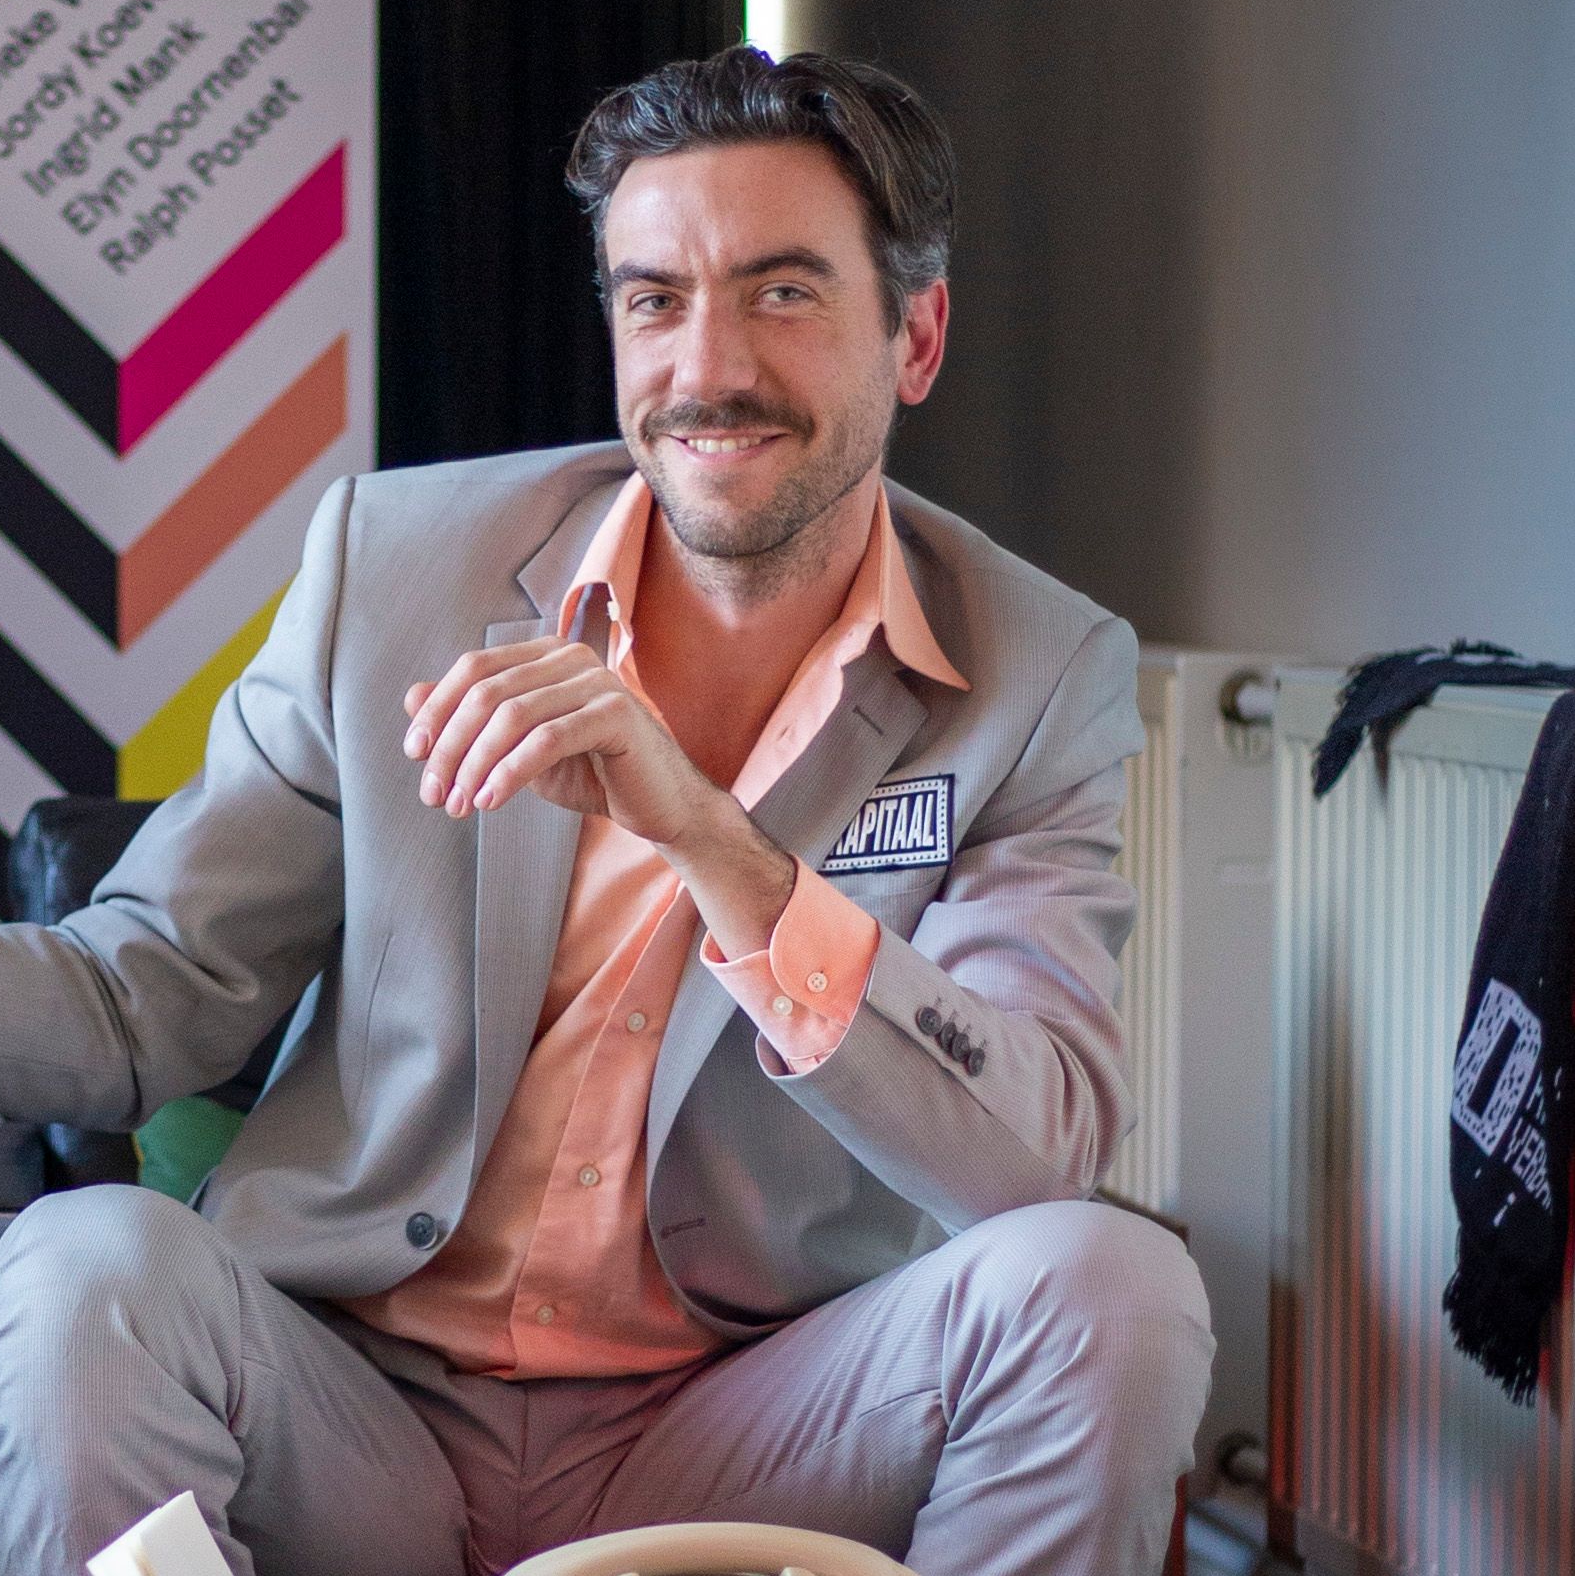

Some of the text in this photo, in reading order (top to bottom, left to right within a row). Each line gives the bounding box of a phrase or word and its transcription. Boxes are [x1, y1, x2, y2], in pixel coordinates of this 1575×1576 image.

[23, 99, 119, 195] Ingrid
[100, 79, 300, 273] Ralph Posset
